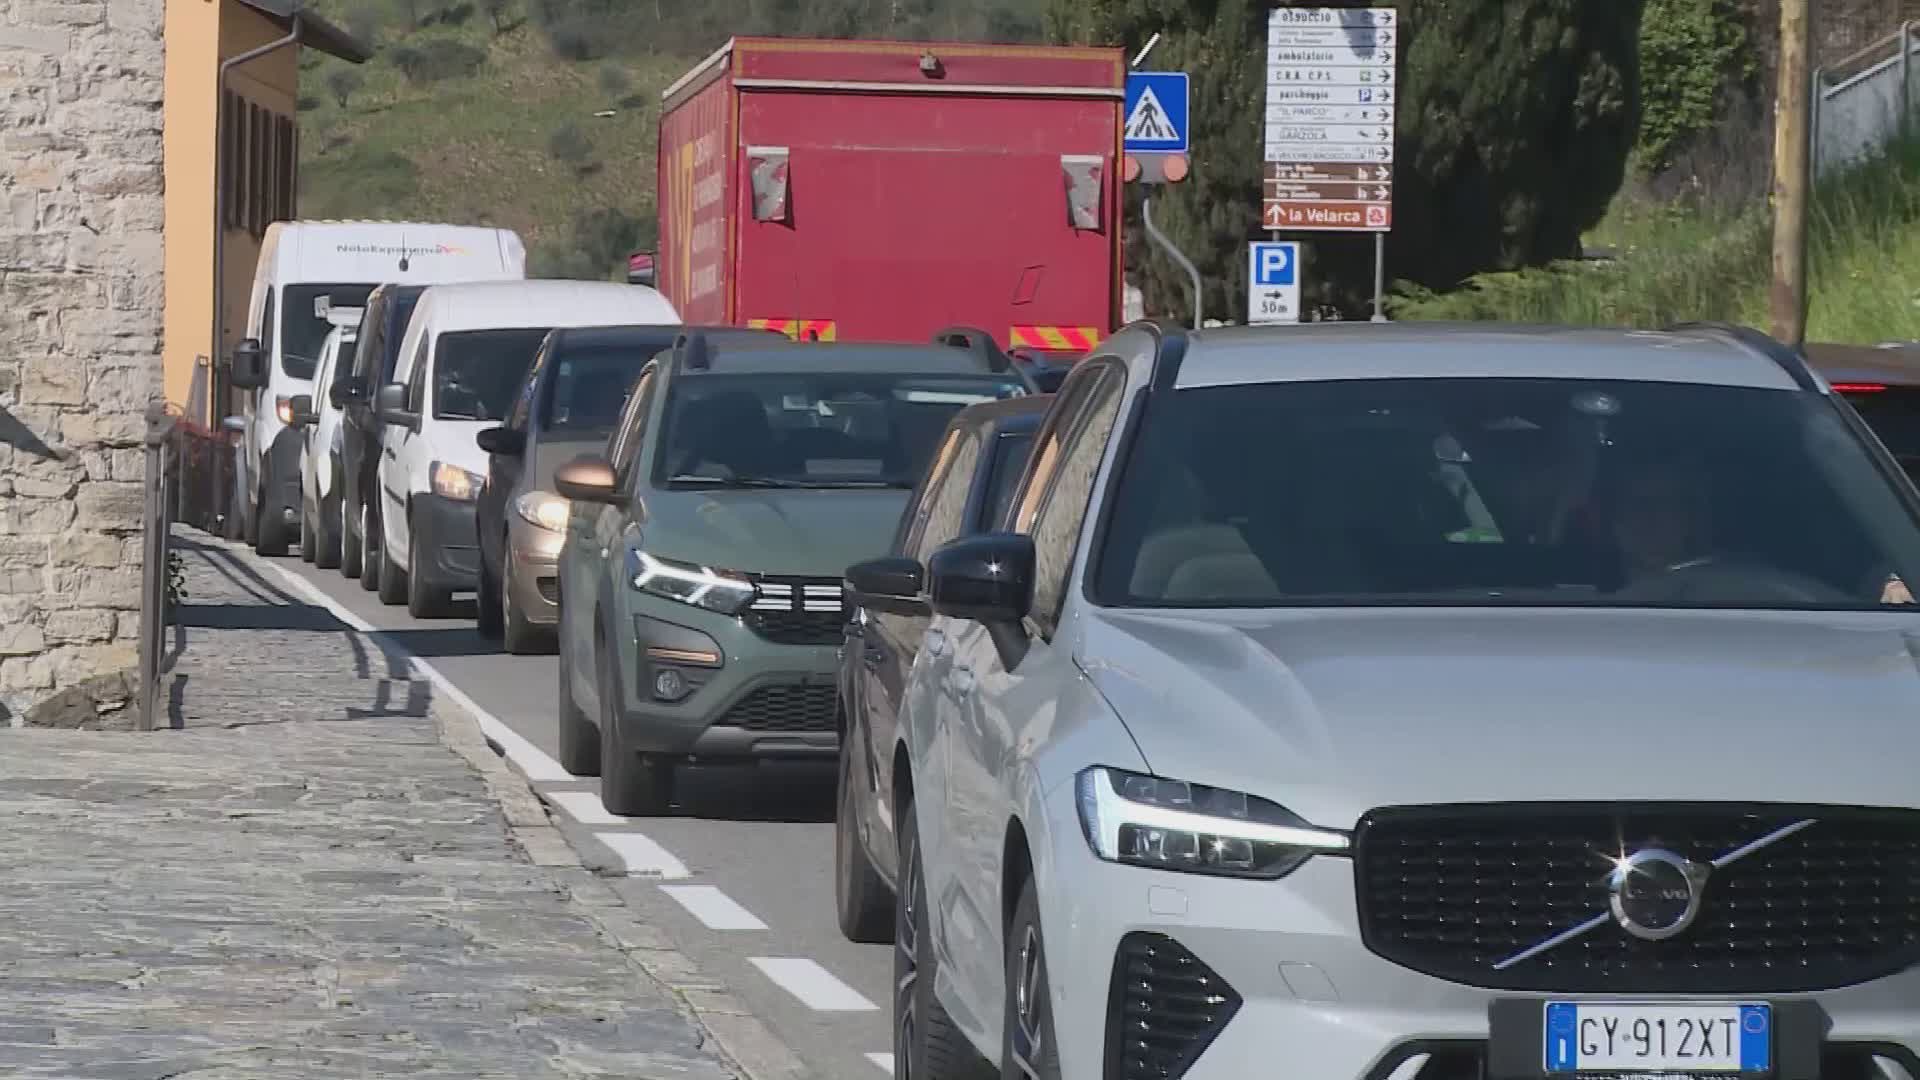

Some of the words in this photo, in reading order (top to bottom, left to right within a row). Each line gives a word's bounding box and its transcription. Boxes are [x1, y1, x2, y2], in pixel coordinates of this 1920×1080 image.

[1280, 89, 1328, 100] parcheggio
[1289, 208, 1302, 221] la
[1306, 208, 1360, 222] Velarca
[1262, 248, 1288, 282] P
